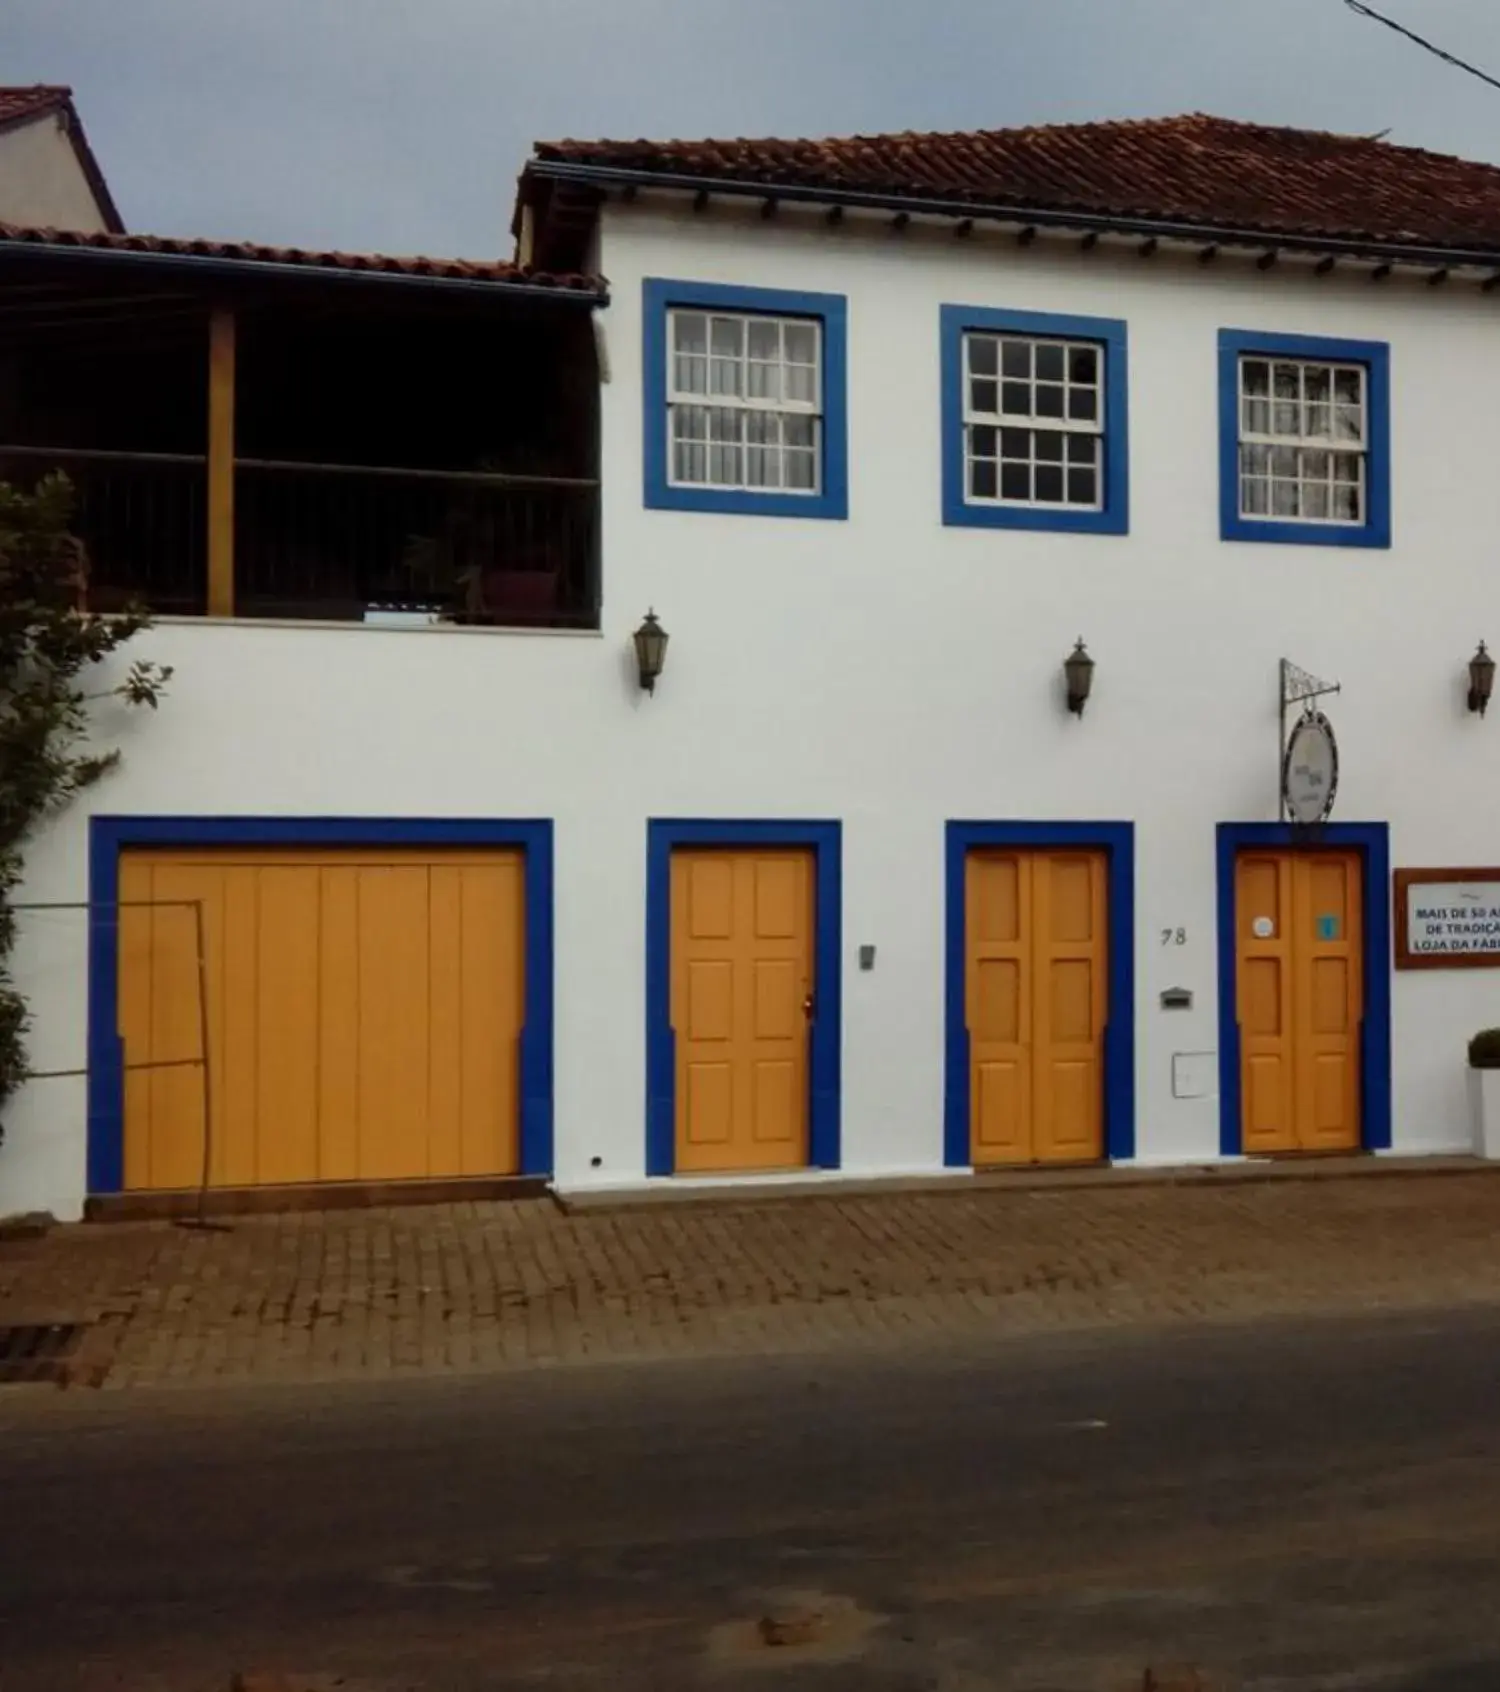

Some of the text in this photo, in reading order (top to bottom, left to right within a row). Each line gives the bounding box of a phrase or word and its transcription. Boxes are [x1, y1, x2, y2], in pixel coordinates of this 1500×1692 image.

[1416, 908, 1447, 919] MAIS
[1451, 907, 1467, 919] DE
[1426, 924, 1443, 935] DE
[1161, 928, 1187, 946] 78
[1414, 940, 1447, 951] LOJA
[1451, 940, 1469, 950] DA
